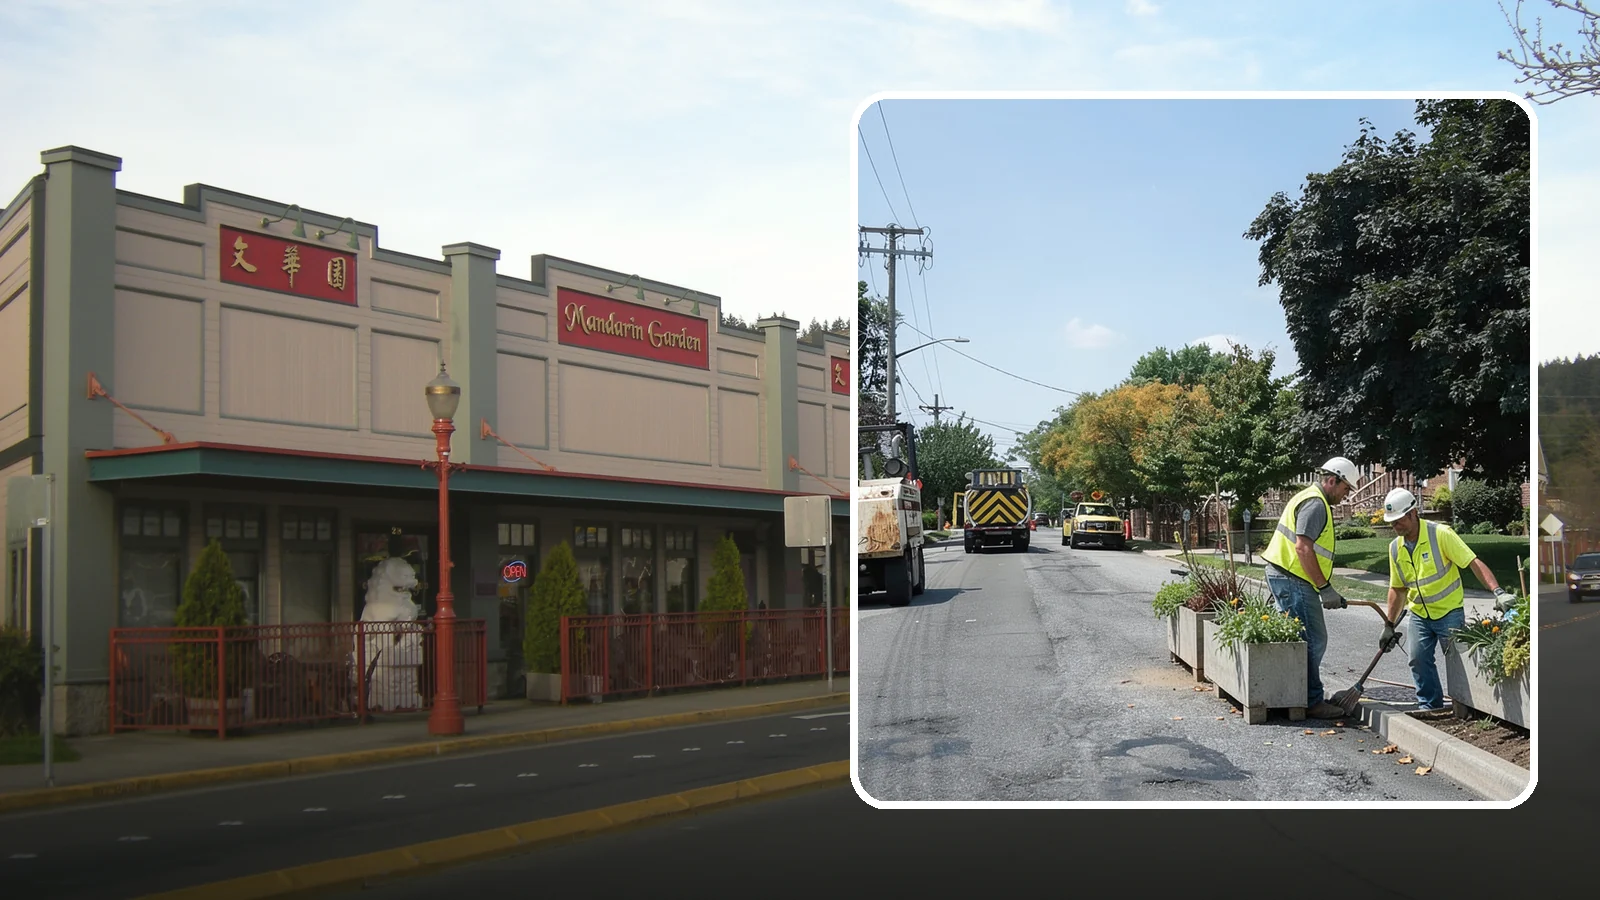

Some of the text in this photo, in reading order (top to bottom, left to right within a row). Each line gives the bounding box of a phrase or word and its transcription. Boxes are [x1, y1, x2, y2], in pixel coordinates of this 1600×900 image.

[230, 235, 346, 291] 文華園
[564, 302, 701, 352] Mandarin Garden
[834, 363, 846, 386] 文
[503, 565, 526, 578] OPEN
